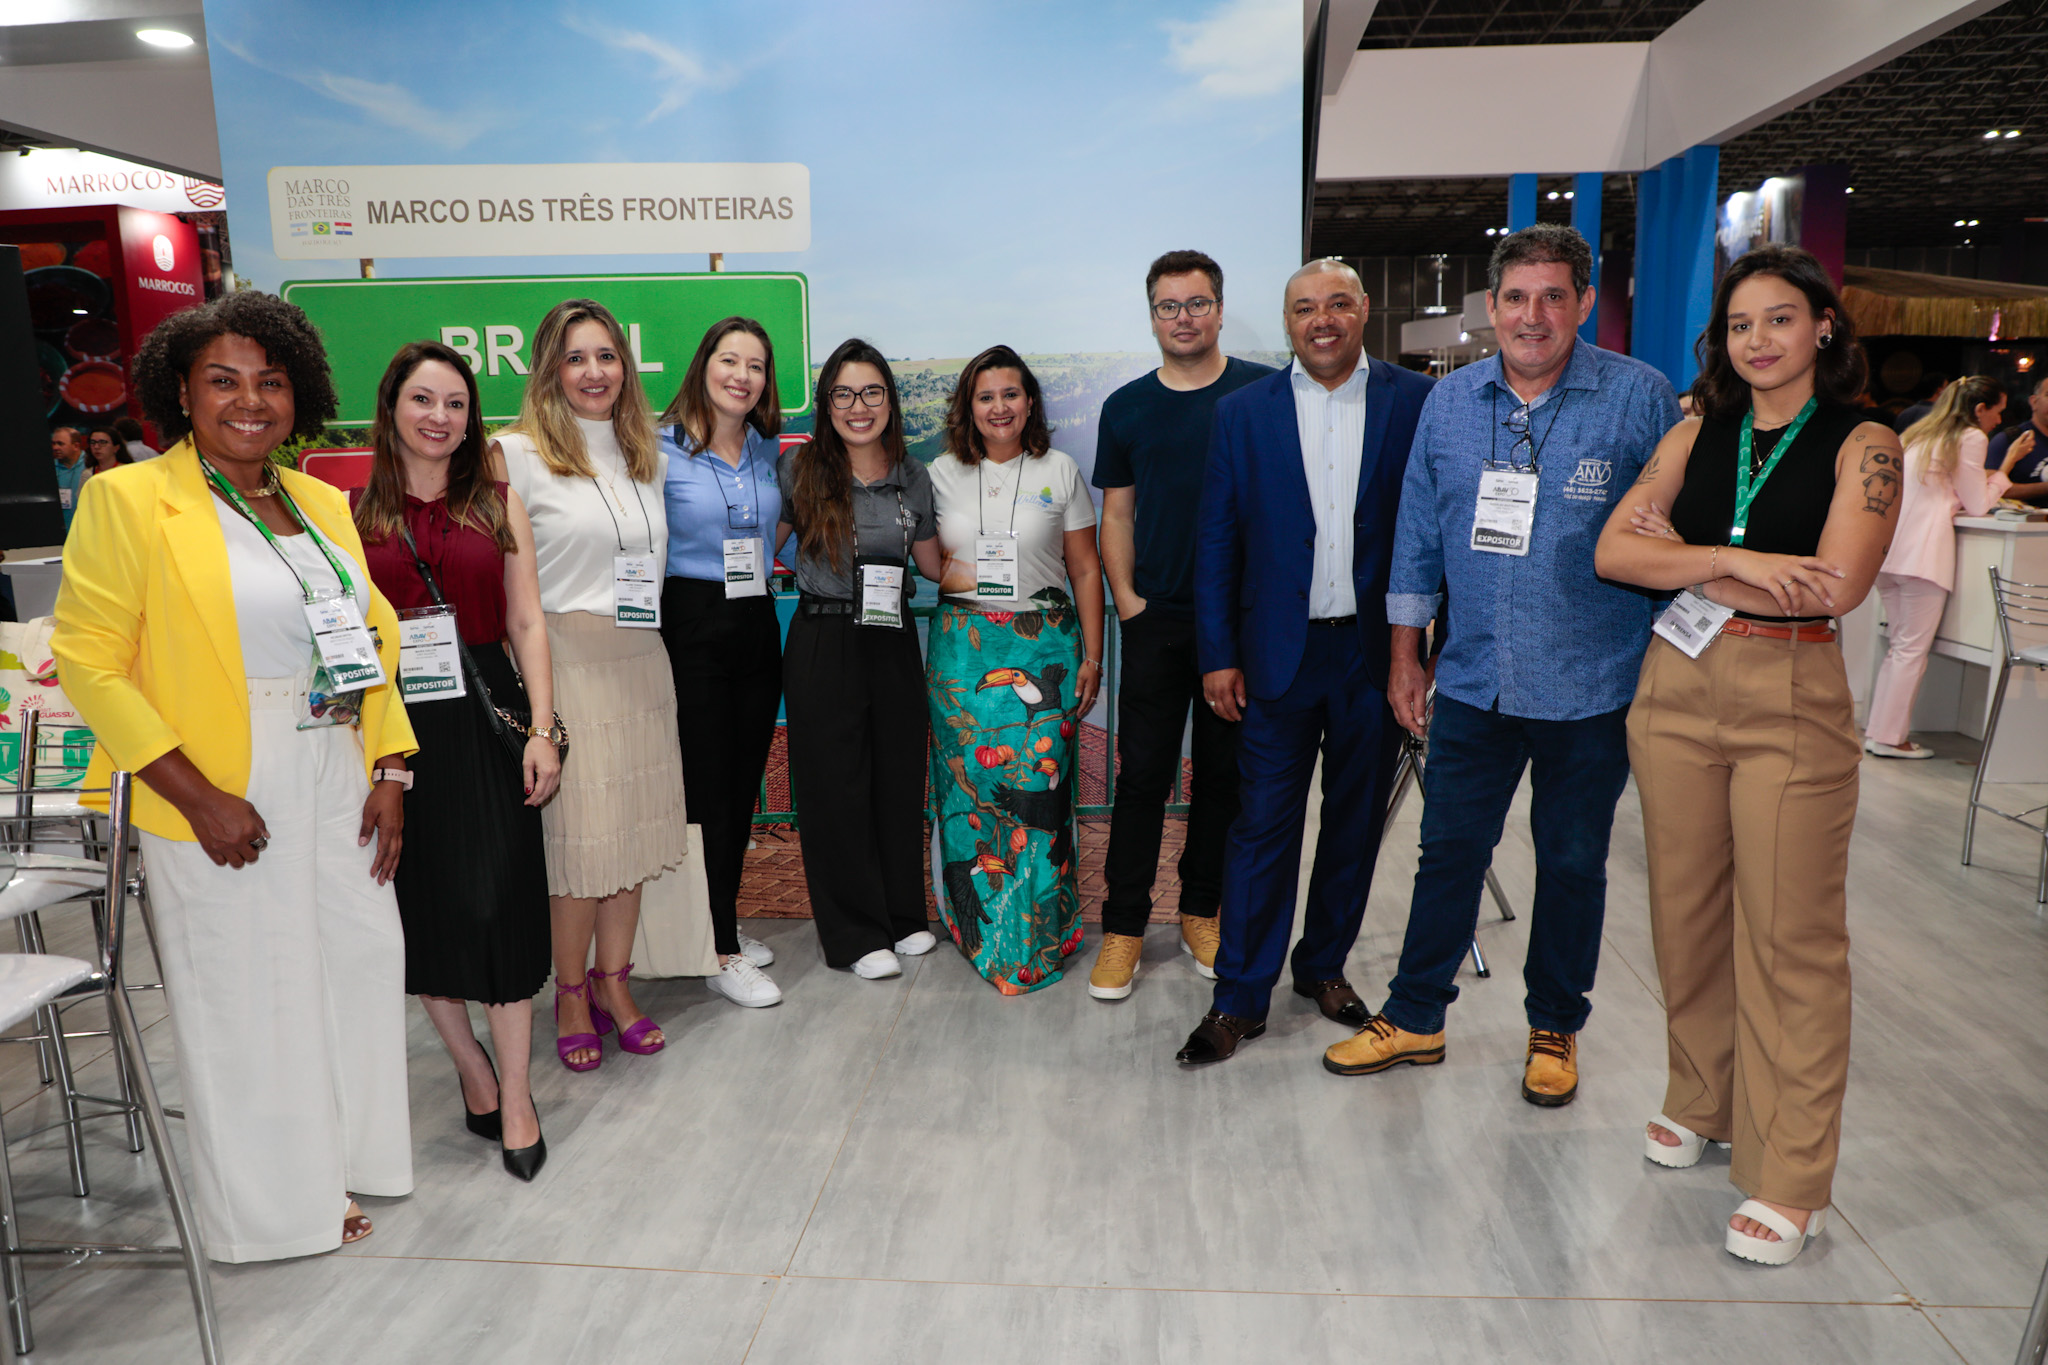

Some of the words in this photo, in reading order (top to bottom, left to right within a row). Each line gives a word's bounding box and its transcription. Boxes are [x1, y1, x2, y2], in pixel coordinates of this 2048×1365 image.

[46, 169, 176, 195] MARROCOS
[285, 179, 350, 195] MARCO
[288, 195, 314, 208] DAS
[317, 193, 351, 208] TRÊS
[288, 209, 352, 220] FRONTEIRAS
[367, 198, 470, 225] MARCO
[479, 198, 535, 224] DAS
[542, 192, 614, 222] TRÊS
[623, 195, 794, 222] FRONTEIRAS
[138, 276, 195, 296] MARROCOS
[1476, 534, 1521, 547] EXPOSITOR
[978, 586, 1012, 594] EXPOSITOR
[619, 611, 654, 620] EXPOSITOR
[332, 665, 378, 683] EXPOSITOR
[405, 679, 454, 692] EXPOSITOR
